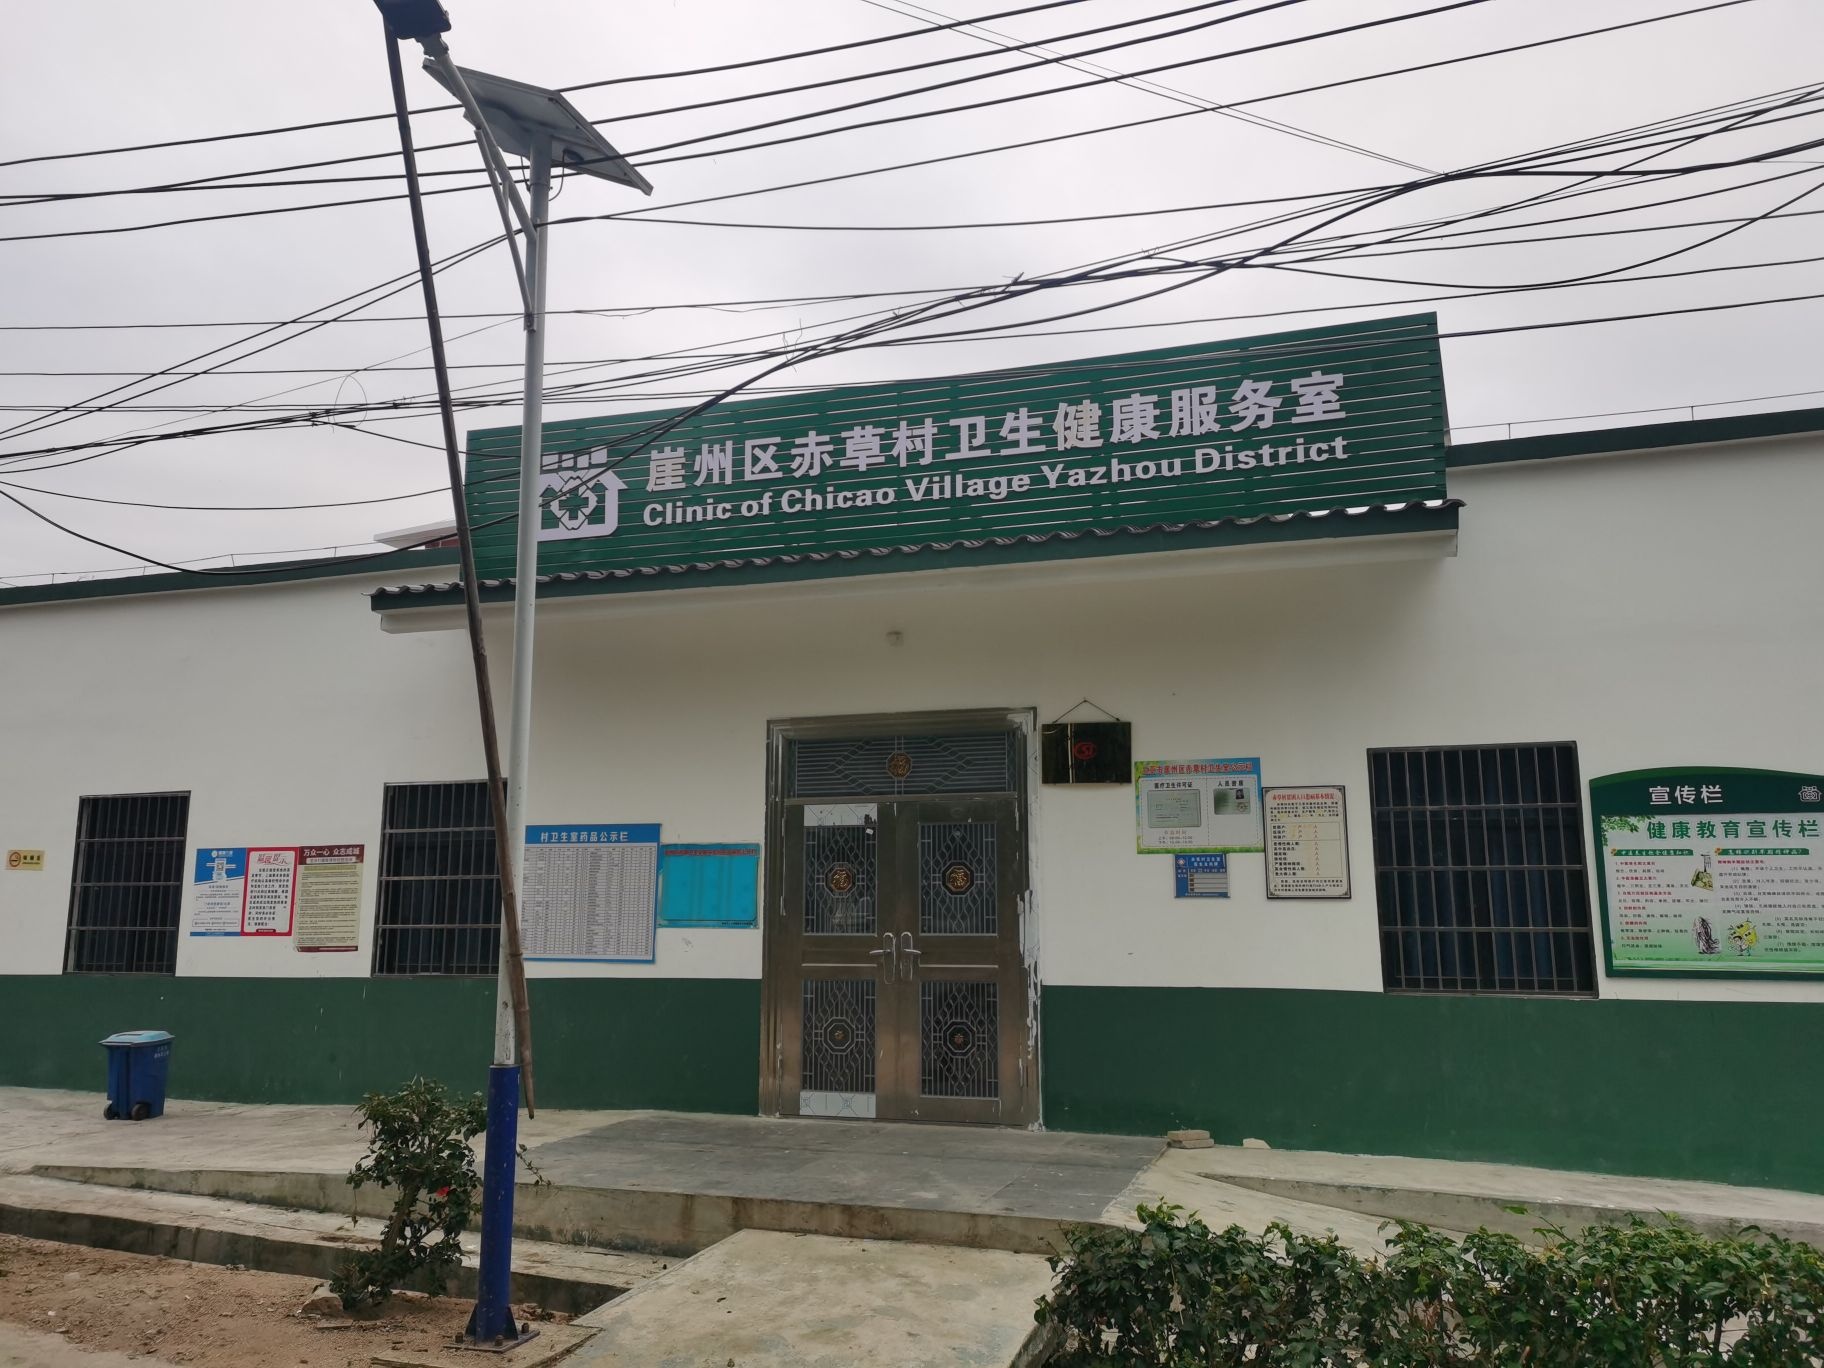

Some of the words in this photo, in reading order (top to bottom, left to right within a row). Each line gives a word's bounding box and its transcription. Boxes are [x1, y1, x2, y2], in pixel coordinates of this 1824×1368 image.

[646, 371, 1346, 492] 崖州区赤草村卫生健康服务室
[643, 498, 732, 526] Clinic
[740, 492, 772, 516] of
[781, 486, 895, 513] Chicao
[905, 474, 1031, 500] Village
[1041, 458, 1181, 489] Yazhou
[1195, 436, 1348, 474] District
[1649, 785, 1723, 805] 宣传栏
[1646, 819, 1820, 840] 健康教育宣传栏
